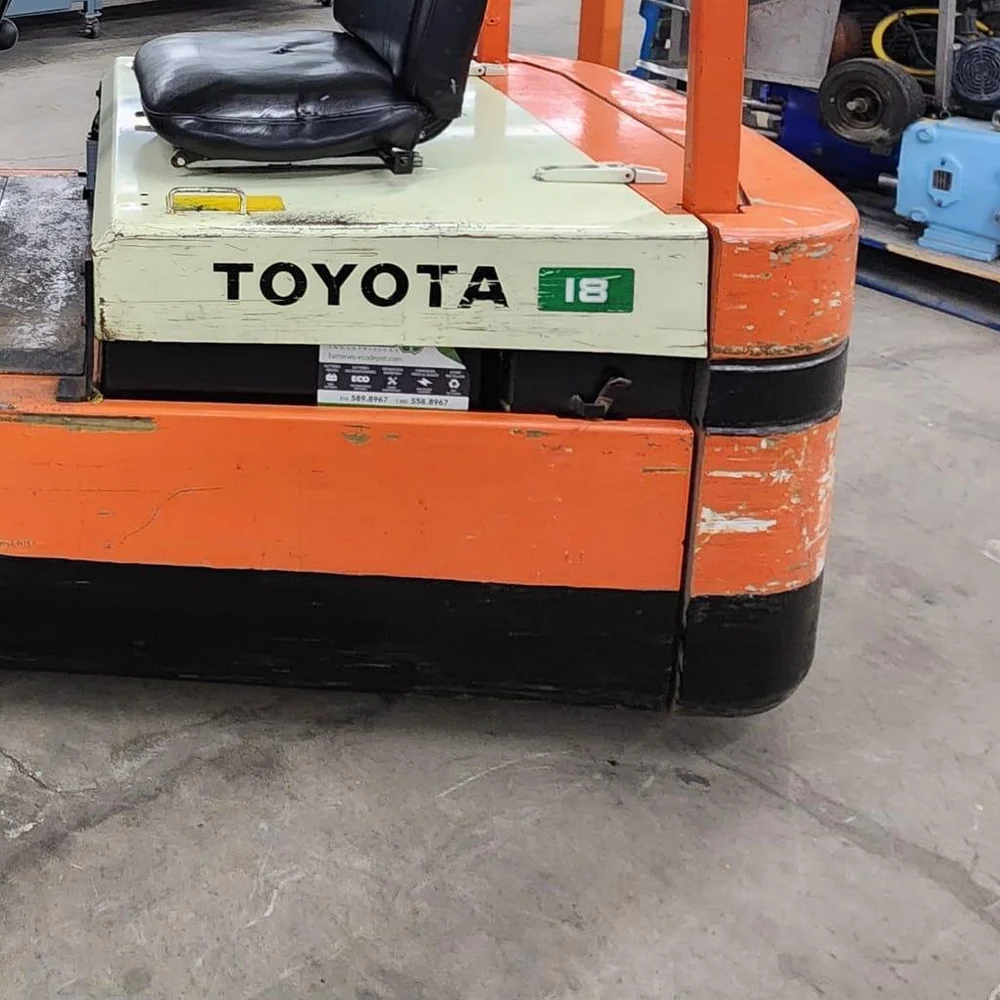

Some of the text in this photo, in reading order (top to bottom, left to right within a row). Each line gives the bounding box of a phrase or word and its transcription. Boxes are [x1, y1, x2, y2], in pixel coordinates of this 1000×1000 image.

[213, 262, 608, 307] TOYOTA 18
[351, 375, 370, 383] ECO
